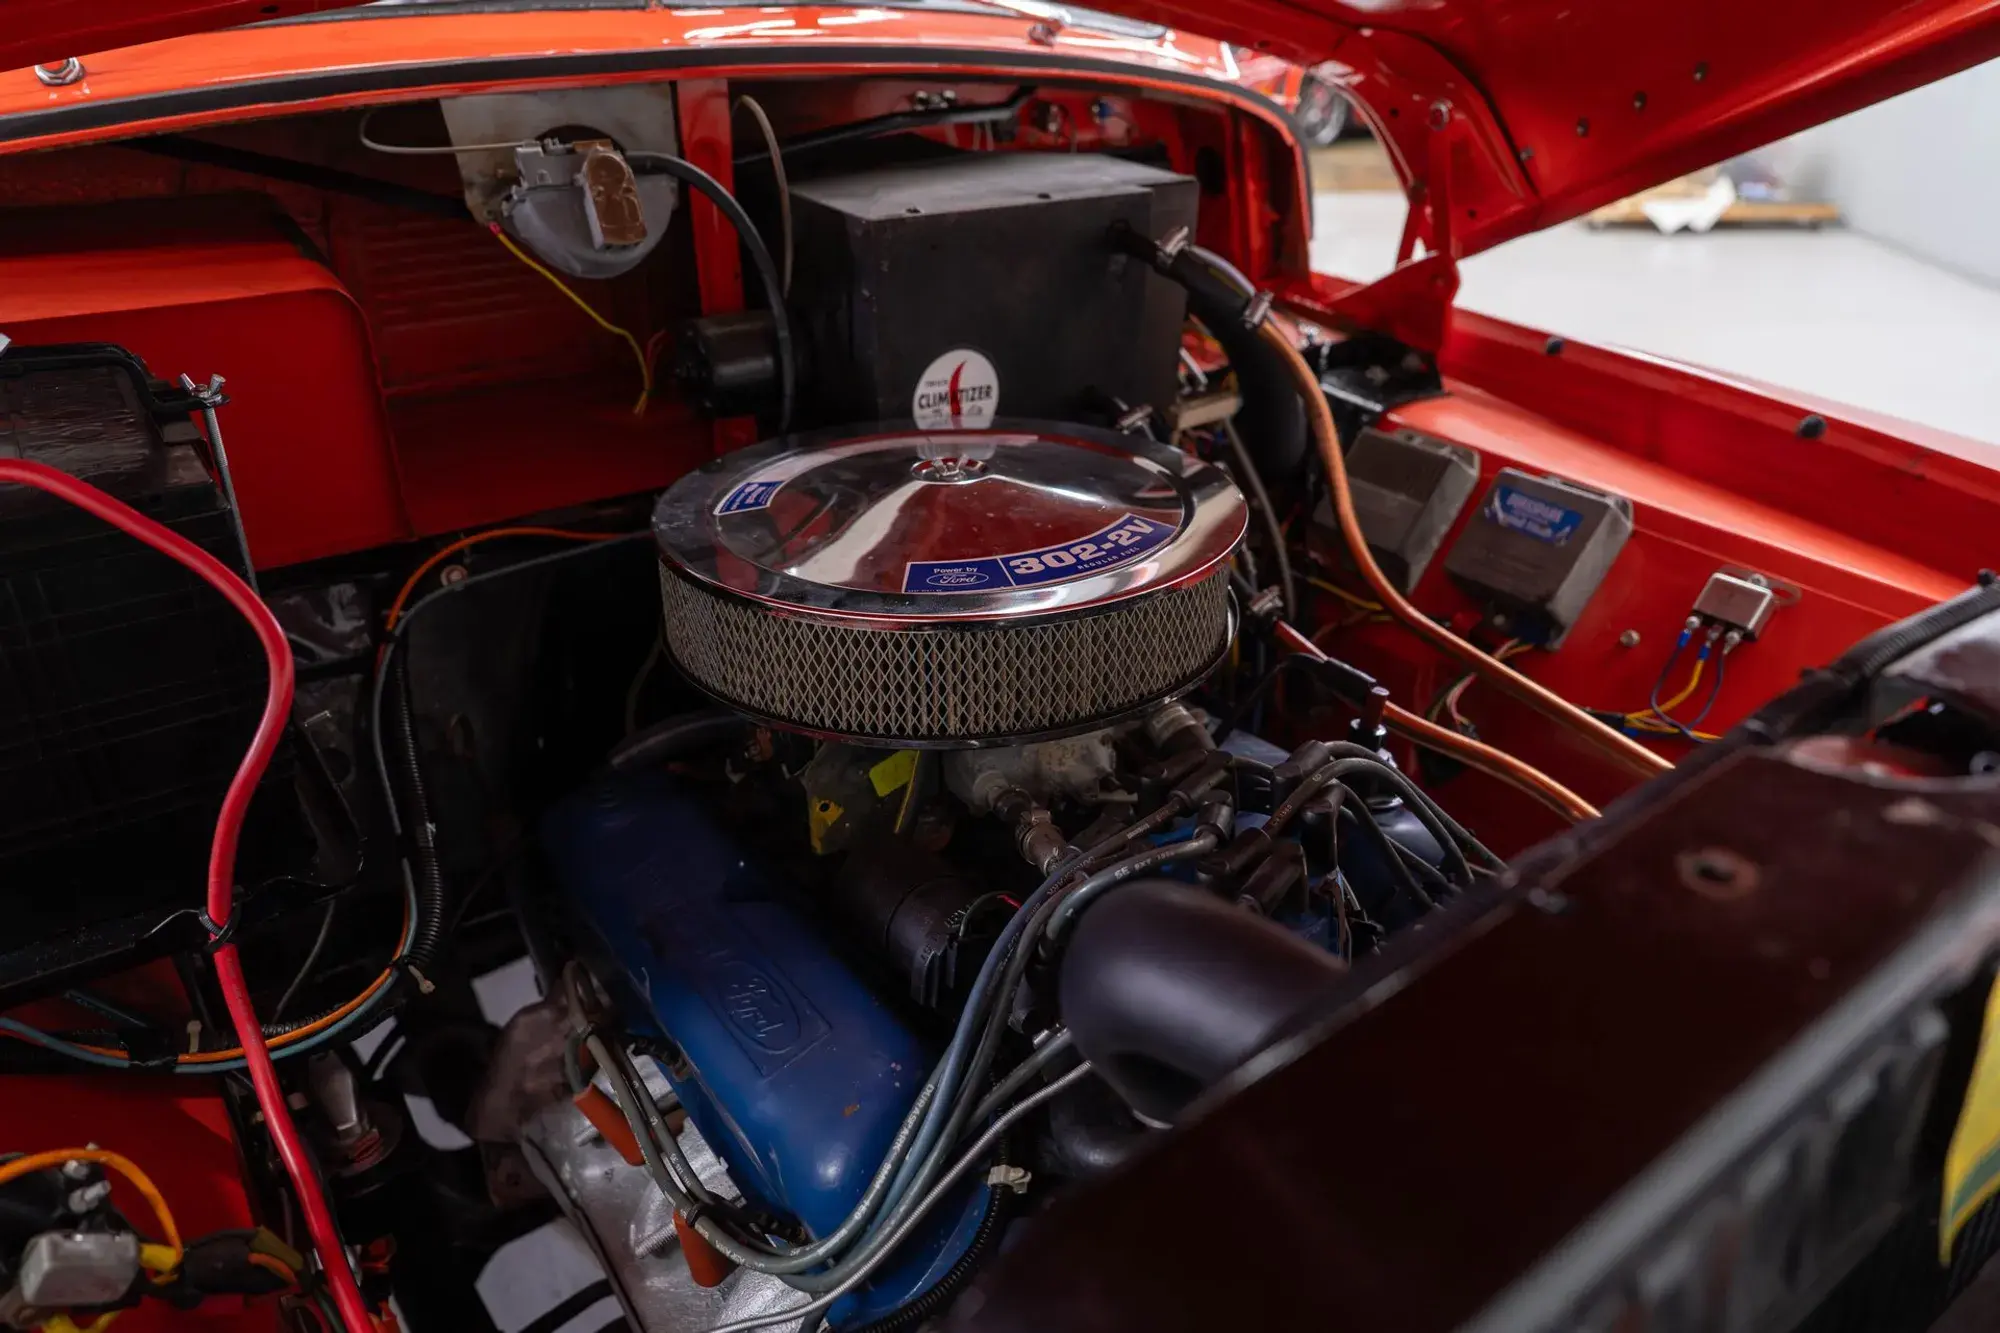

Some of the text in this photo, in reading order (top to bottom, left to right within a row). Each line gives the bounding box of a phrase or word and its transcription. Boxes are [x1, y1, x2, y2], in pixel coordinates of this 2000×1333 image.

[1009, 519, 1154, 575] 302-2V
[1077, 546, 1140, 570] REGULAR FUEL
[933, 567, 963, 575] Power
[939, 573, 977, 584] Ford
[892, 1083, 935, 1153] DURASPARK
